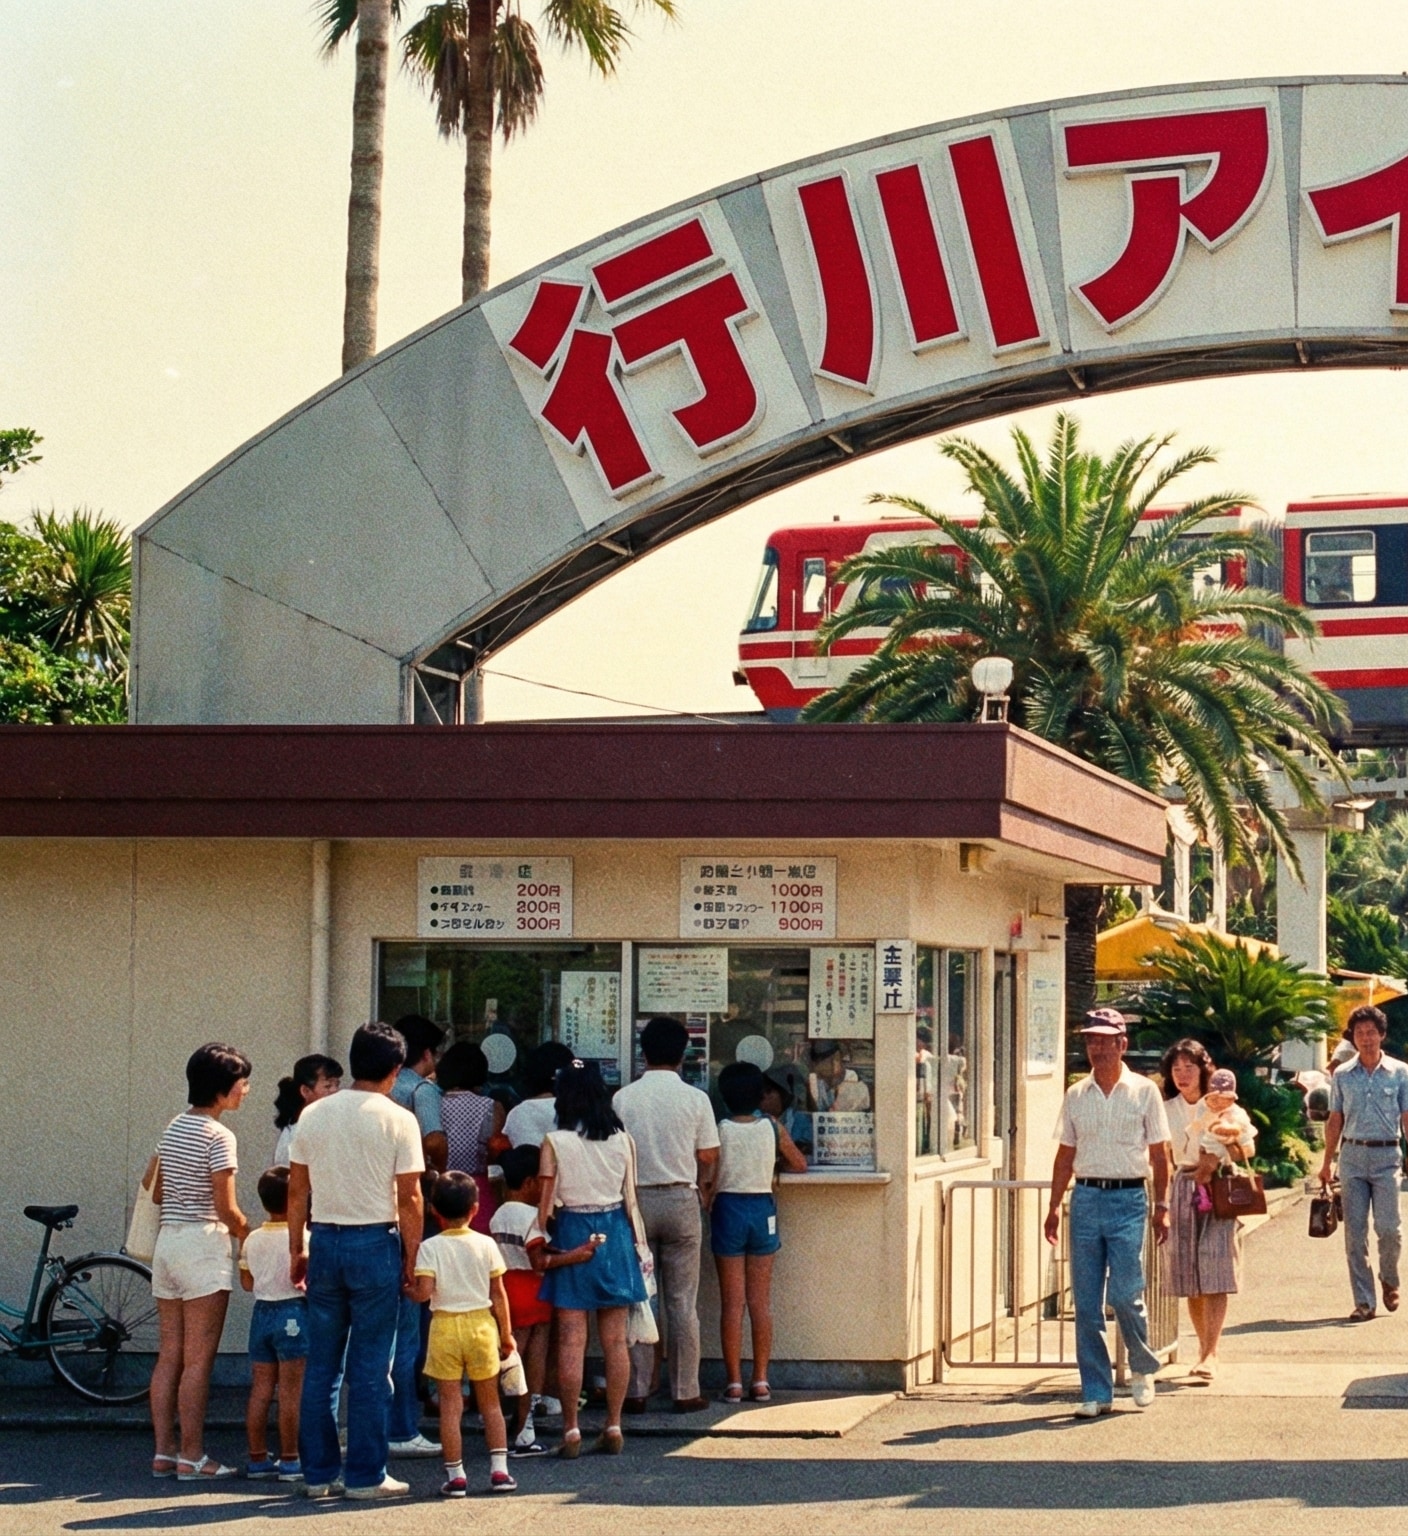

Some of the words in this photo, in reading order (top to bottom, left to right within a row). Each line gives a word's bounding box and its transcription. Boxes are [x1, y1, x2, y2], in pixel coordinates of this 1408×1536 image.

[516, 883, 561, 897] 200円
[771, 883, 823, 897] 1000円
[516, 917, 561, 930] 300円
[778, 917, 823, 930] 900円
